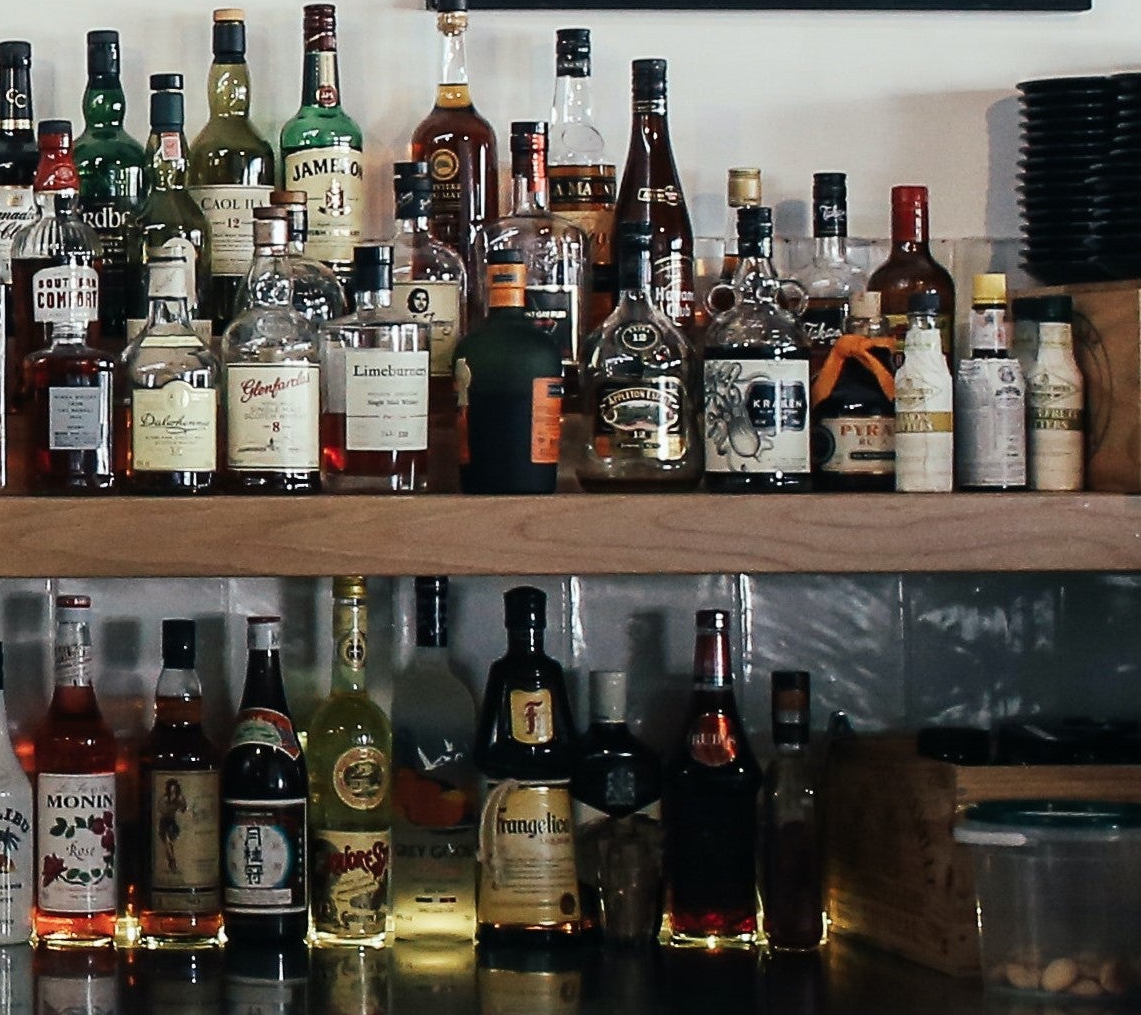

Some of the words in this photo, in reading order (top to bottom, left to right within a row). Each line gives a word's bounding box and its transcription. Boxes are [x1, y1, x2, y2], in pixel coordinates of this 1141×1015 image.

[201, 197, 240, 210] CAOL
[226, 218, 240, 228] 12
[272, 422, 280, 432] 8
[47, 795, 113, 808] MONIN
[66, 842, 95, 860] Rose
